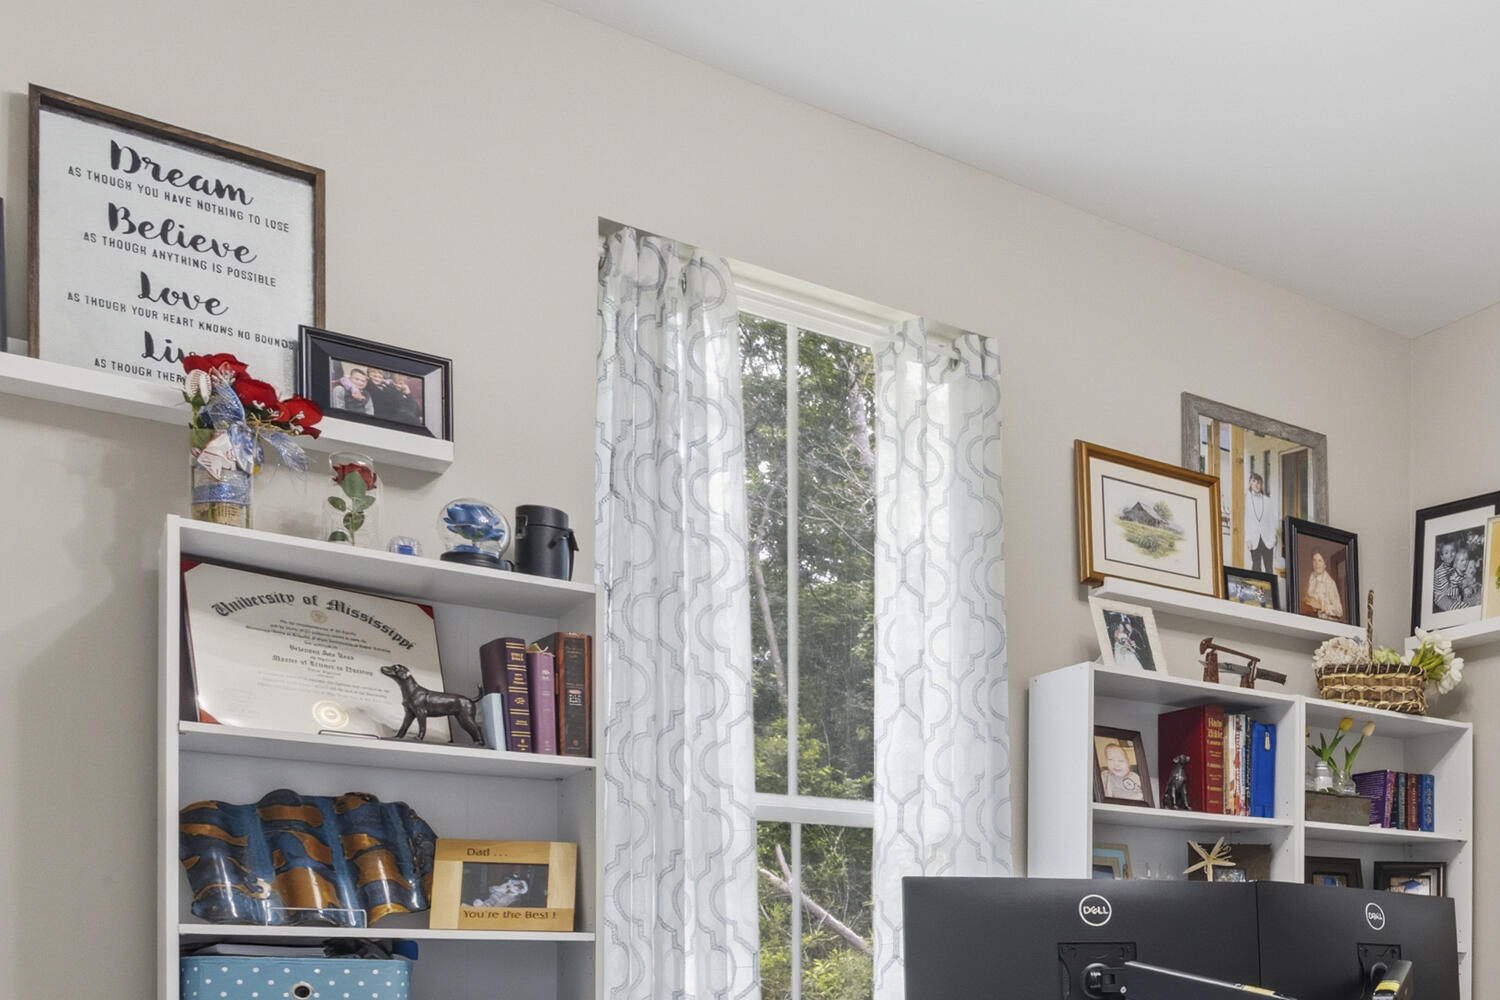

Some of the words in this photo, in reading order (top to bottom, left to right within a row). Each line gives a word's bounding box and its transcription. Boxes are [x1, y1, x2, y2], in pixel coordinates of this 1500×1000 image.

[109, 139, 254, 206] Dream
[67, 165, 82, 178] AS
[87, 169, 132, 191] THOUGH
[137, 183, 159, 198] YOU
[164, 191, 192, 207] HAVE
[197, 199, 244, 221] NOTHING
[248, 213, 261, 225] TO
[265, 218, 290, 233] LOSE
[108, 201, 257, 264] Believe
[83, 231, 97, 243] AS
[102, 235, 147, 255] THOUGH
[152, 248, 208, 271] ANYTHING
[212, 263, 223, 274] IS
[227, 266, 277, 287] POSSIBLE
[138, 271, 229, 316] Love
[67, 291, 80, 302] AS
[85, 295, 127, 312] THOUGH
[132, 305, 158, 319] YOUR
[162, 312, 194, 328] HEART
[199, 321, 234, 337] KNOWS
[238, 329, 251, 340] NO
[255, 333, 296, 351] BOUNDS
[94, 357, 107, 368] AS
[111, 361, 152, 377] THOUGH
[141, 330, 213, 364] Liv
[211, 591, 296, 617] University
[302, 594, 318, 607] of
[326, 598, 415, 651] Mississippi
[466, 847, 490, 857] Dad
[463, 909, 500, 920] You're
[503, 910, 522, 919] the
[525, 910, 549, 920] Best
[1082, 905, 1109, 915] DELL
